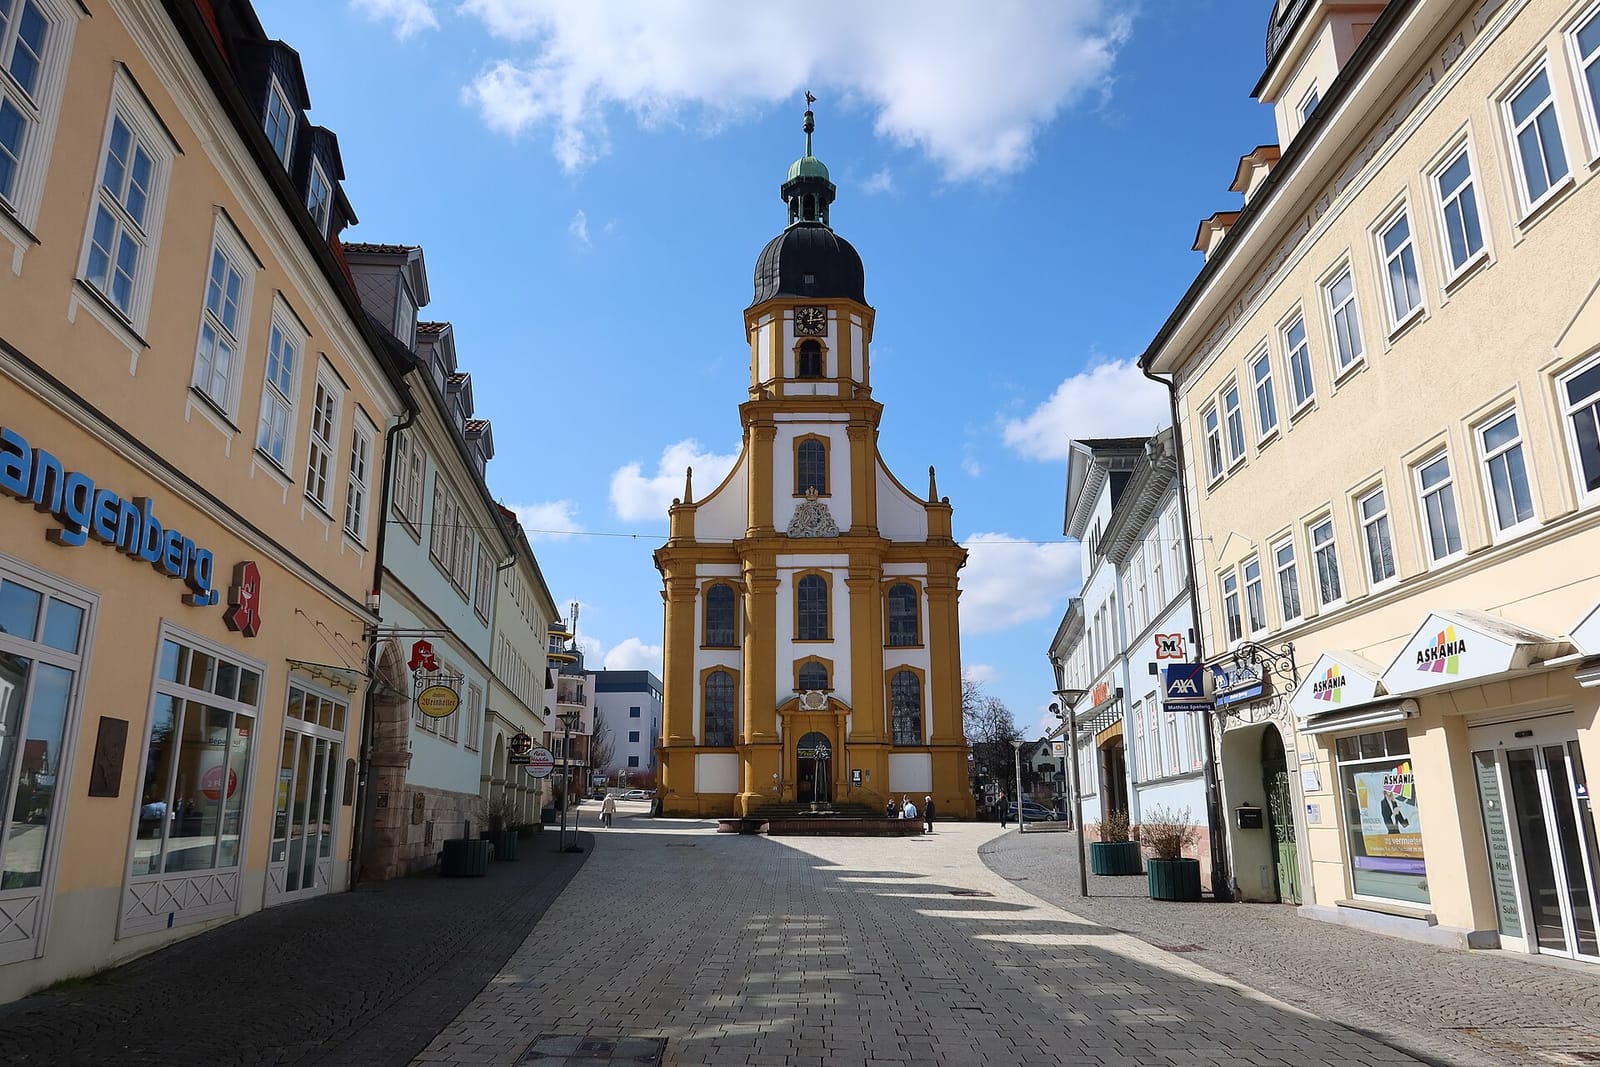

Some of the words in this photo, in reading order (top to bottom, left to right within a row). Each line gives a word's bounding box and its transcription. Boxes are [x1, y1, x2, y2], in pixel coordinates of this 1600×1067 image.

[1162, 641, 1176, 652] M
[1416, 639, 1467, 664] ASKANIA
[1167, 678, 1198, 694] AXA
[1313, 675, 1346, 693] ASKANIA
[422, 698, 456, 706] Weinkeller
[1496, 861, 1509, 870] Marl
